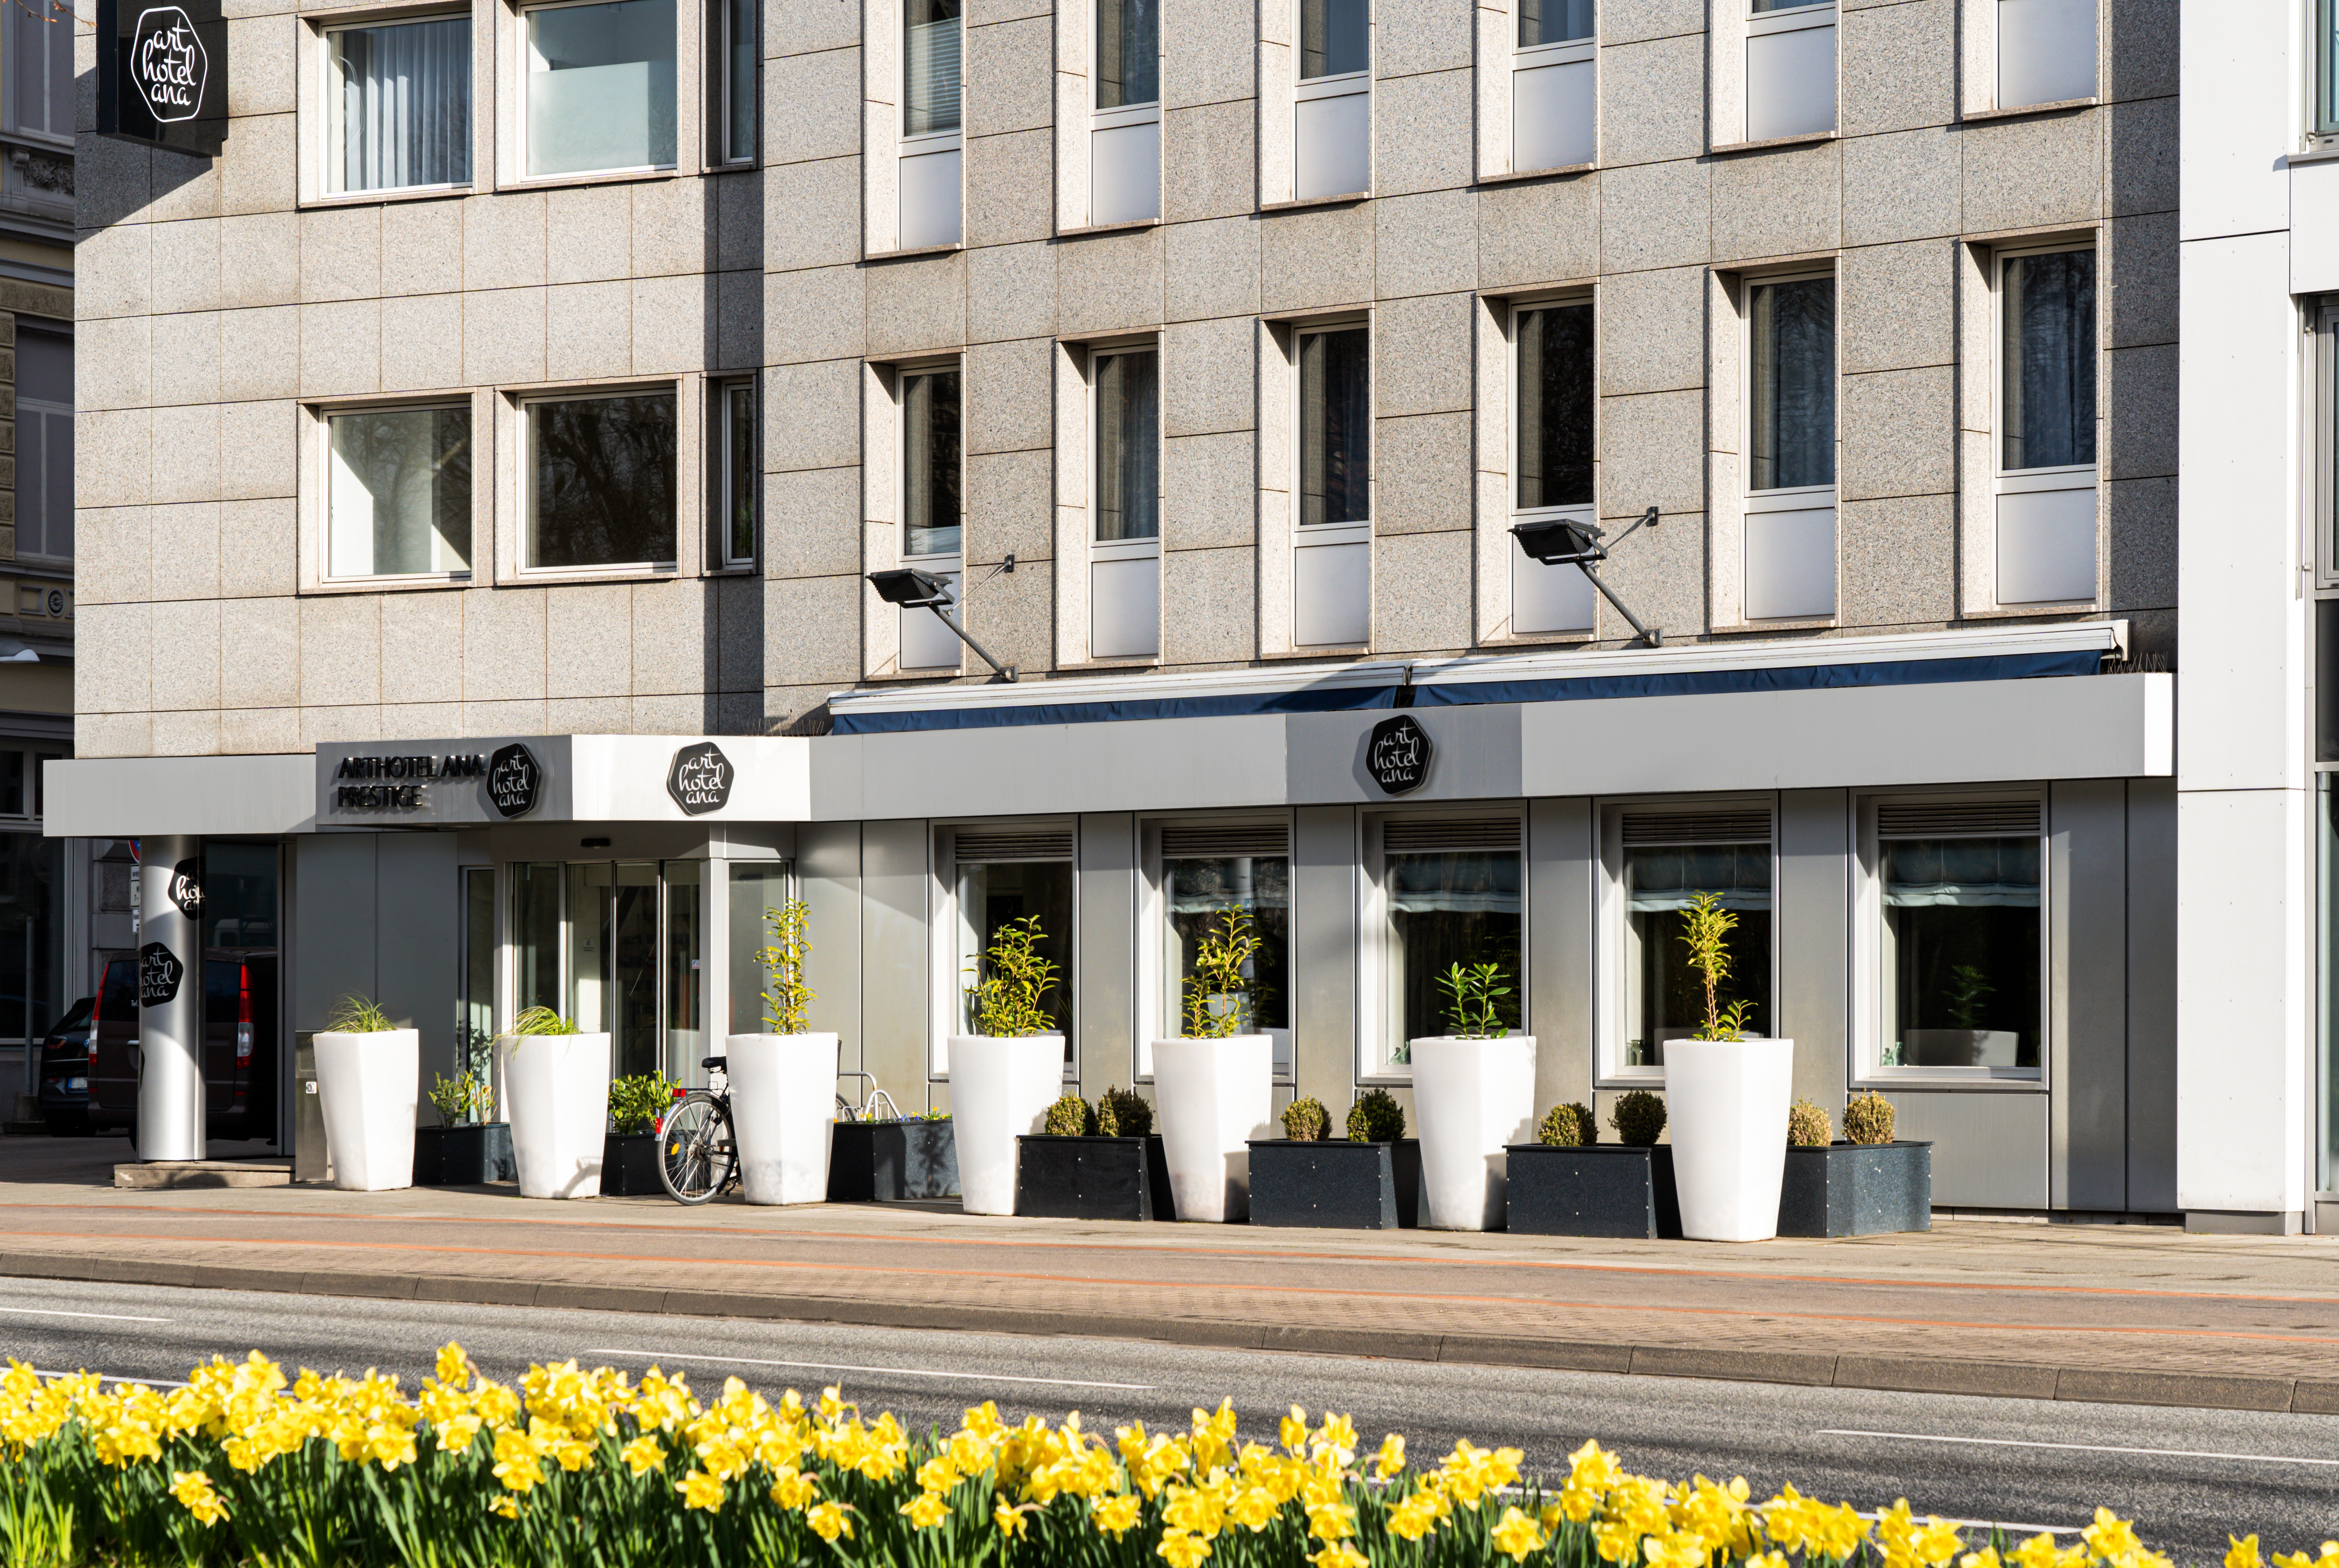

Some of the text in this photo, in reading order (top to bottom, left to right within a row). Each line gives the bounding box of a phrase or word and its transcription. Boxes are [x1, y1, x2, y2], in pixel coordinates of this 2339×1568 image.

[154, 17, 190, 52] art
[143, 39, 196, 86] hotel
[151, 84, 191, 105] ana
[1384, 719, 1416, 746] art
[500, 748, 526, 772] art
[688, 746, 721, 769] art
[1374, 737, 1420, 770] hotel
[338, 755, 486, 778] ARTHOTEL ANA
[679, 763, 726, 791] hotel
[1381, 768, 1416, 783] ana
[493, 764, 530, 795] hotel
[338, 785, 423, 807] PRESTIGE
[499, 792, 527, 807] ana
[686, 790, 721, 804] ana
[141, 946, 169, 968] art
[141, 986, 170, 998] ana
